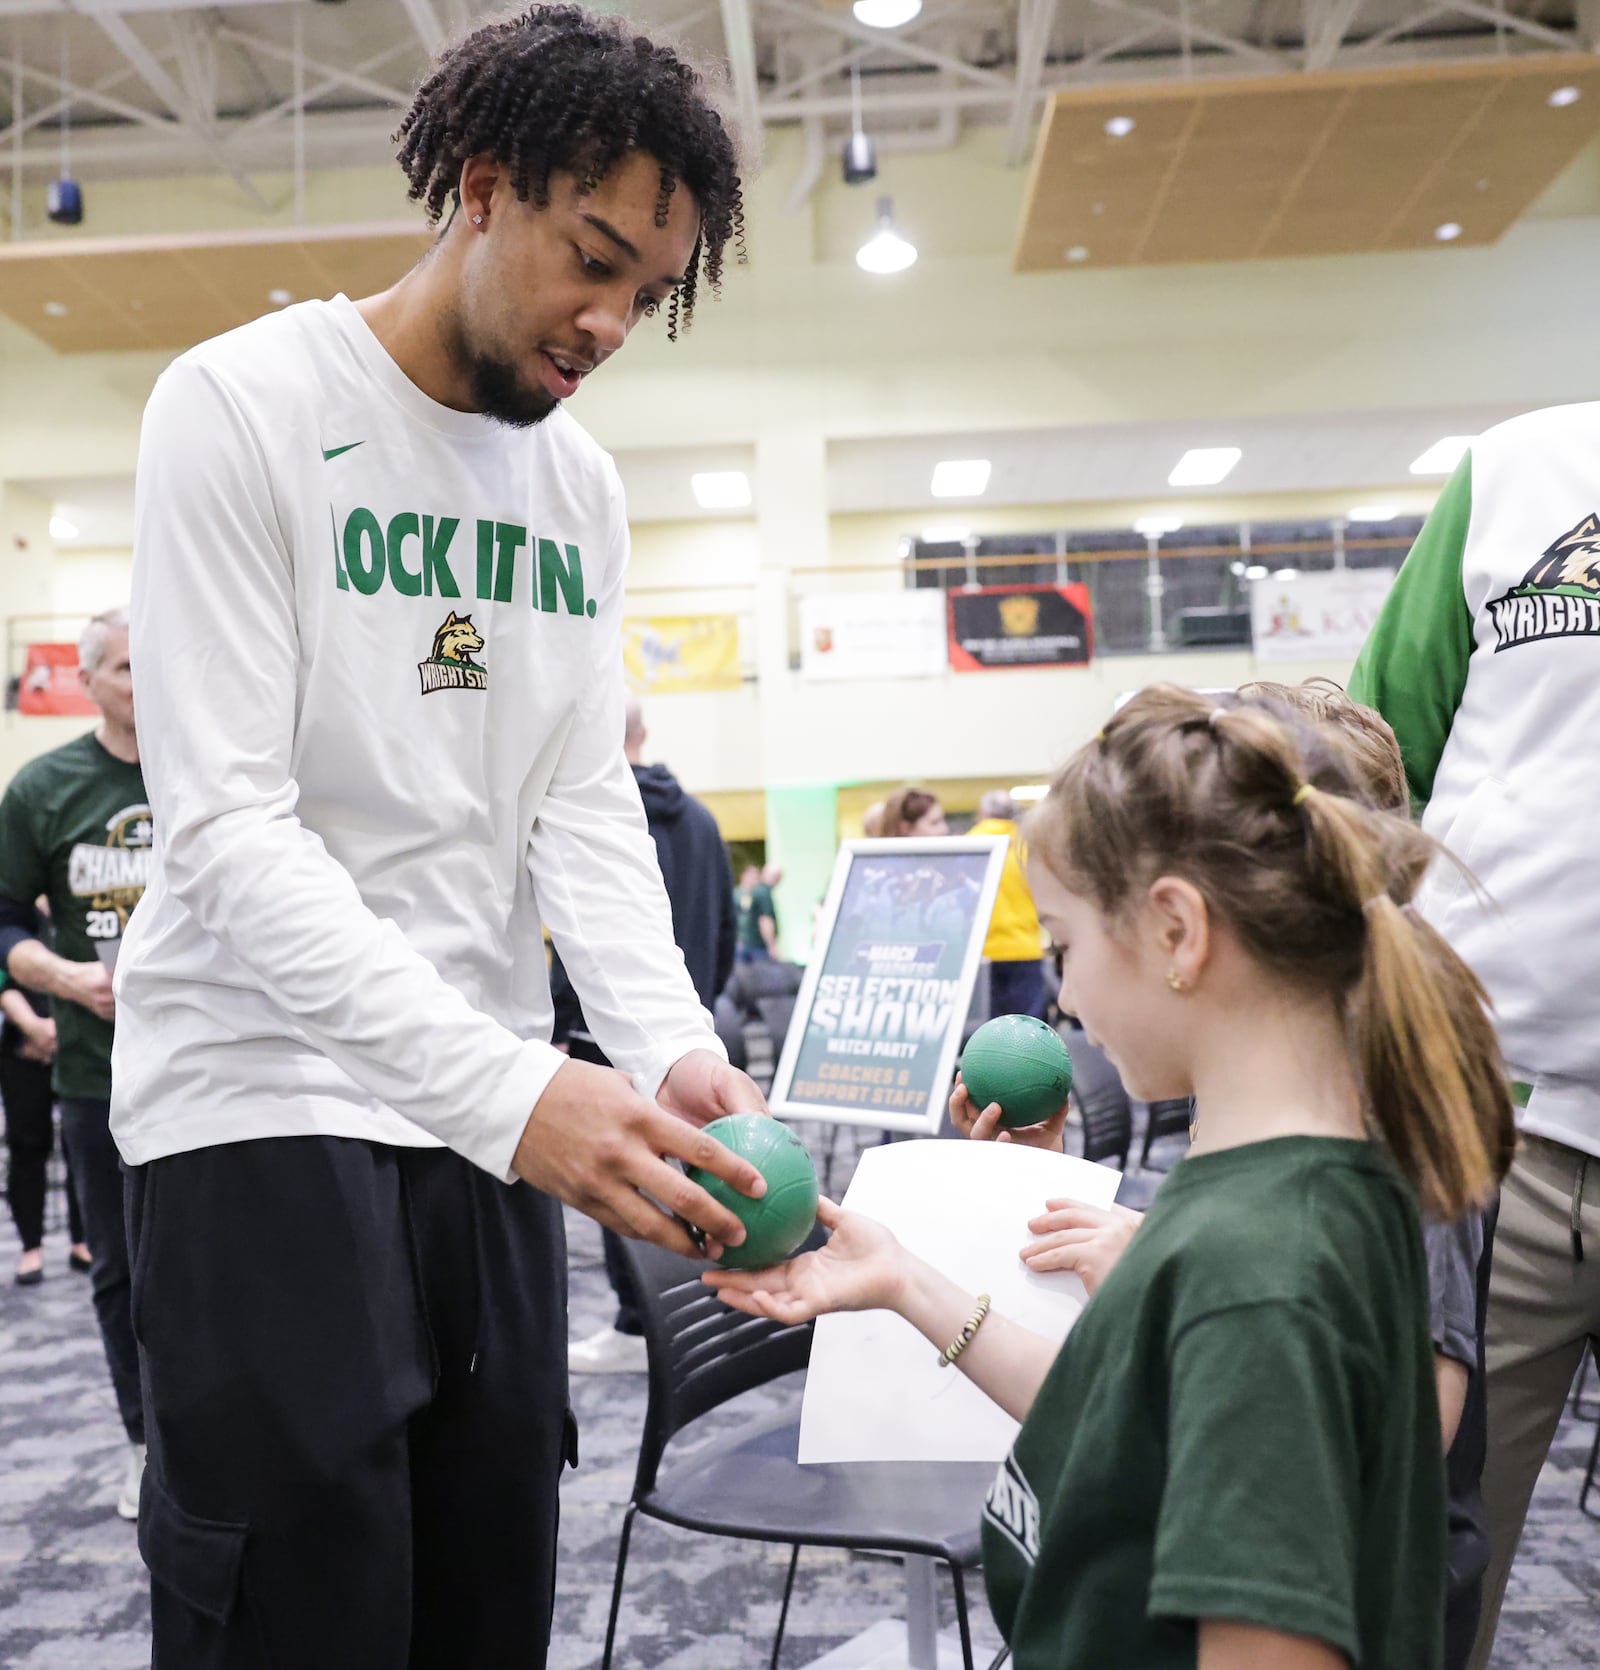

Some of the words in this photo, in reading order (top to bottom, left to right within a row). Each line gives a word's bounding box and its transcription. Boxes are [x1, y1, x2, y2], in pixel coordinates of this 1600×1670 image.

[330, 502, 462, 598] LOCK
[476, 519, 527, 603] IT
[532, 536, 597, 619] IN.
[1492, 595, 1600, 646] WRIGHT
[420, 662, 465, 692] WRIGHT
[86, 911, 118, 938] 20
[868, 944, 918, 961] MARCH
[818, 975, 960, 1005] SELECTION
[810, 1000, 953, 1041] SHOW
[827, 1038, 872, 1056] WATCH
[872, 1041, 919, 1059] PARTY
[818, 1062, 895, 1085] COACHES
[793, 1080, 869, 1102] SUPPORT
[871, 1086, 928, 1109] STAFF
